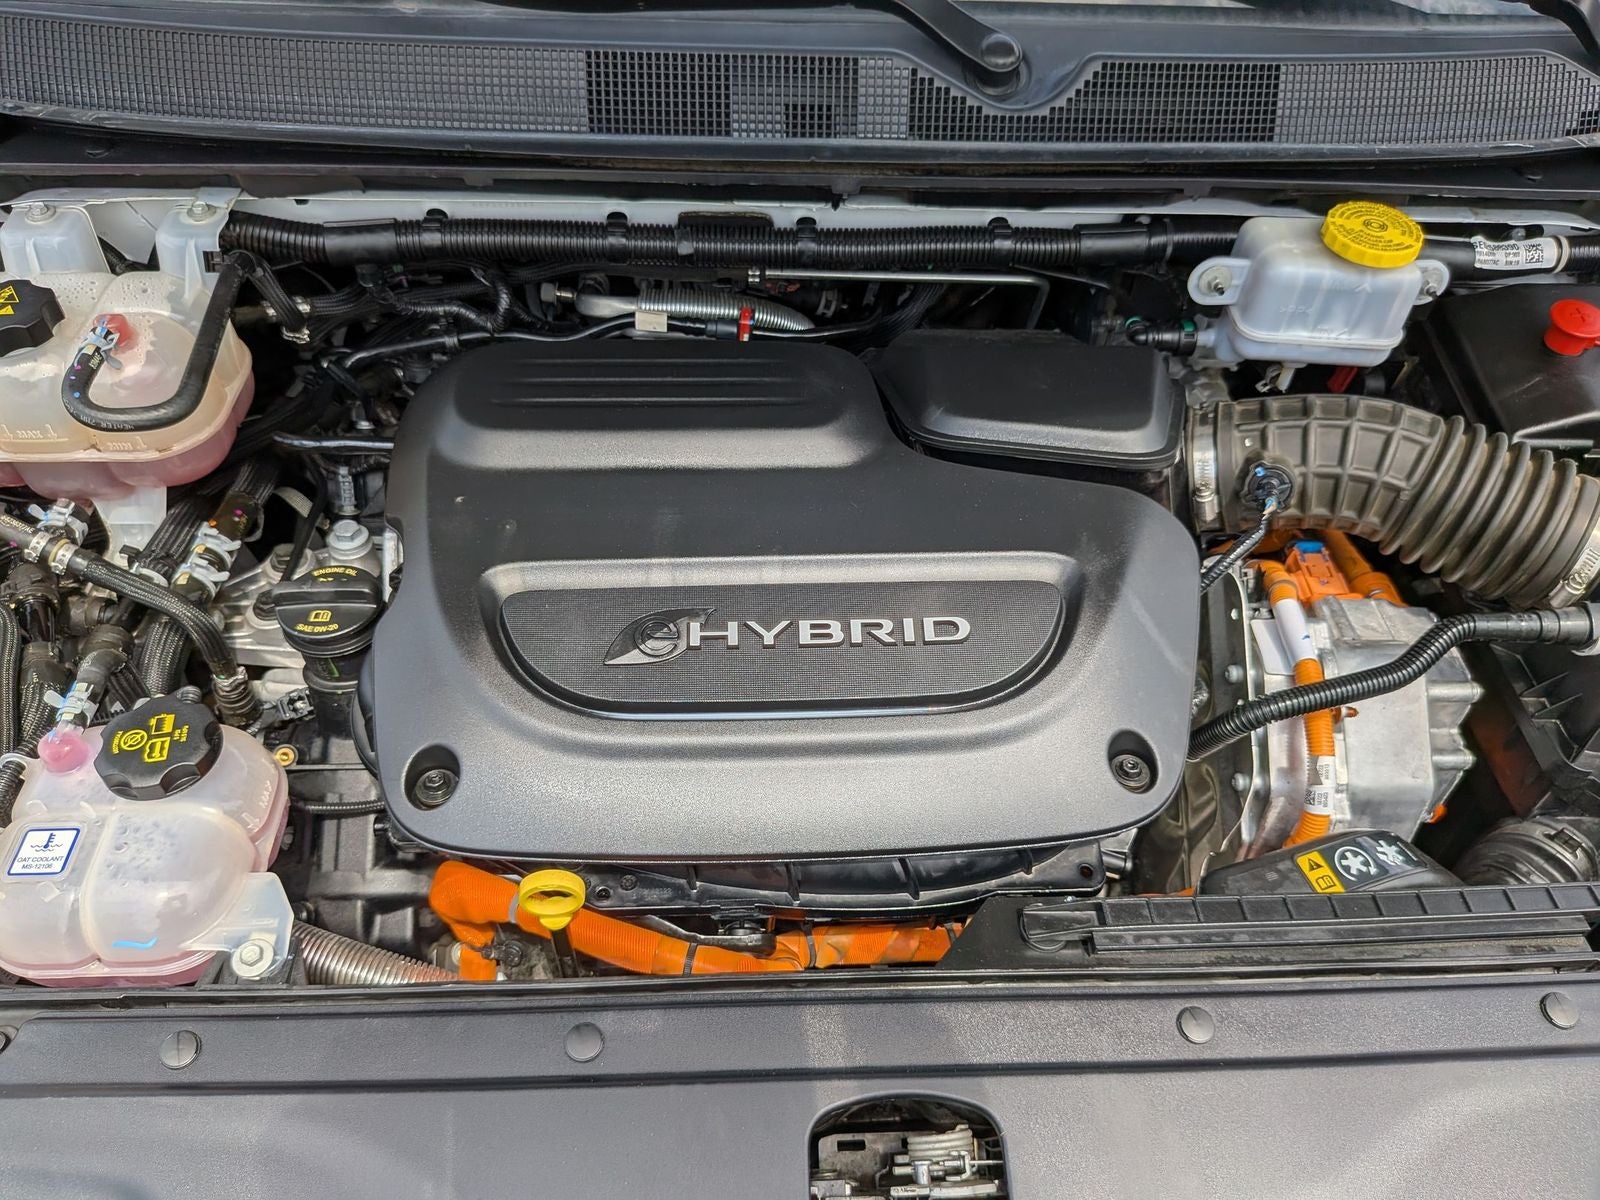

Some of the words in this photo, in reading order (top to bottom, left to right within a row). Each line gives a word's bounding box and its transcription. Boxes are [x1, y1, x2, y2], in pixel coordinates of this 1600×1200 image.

[312, 567, 344, 576] ENGINE
[346, 568, 358, 576] OIL
[297, 623, 313, 632] SAE
[314, 623, 339, 633] 0W-20
